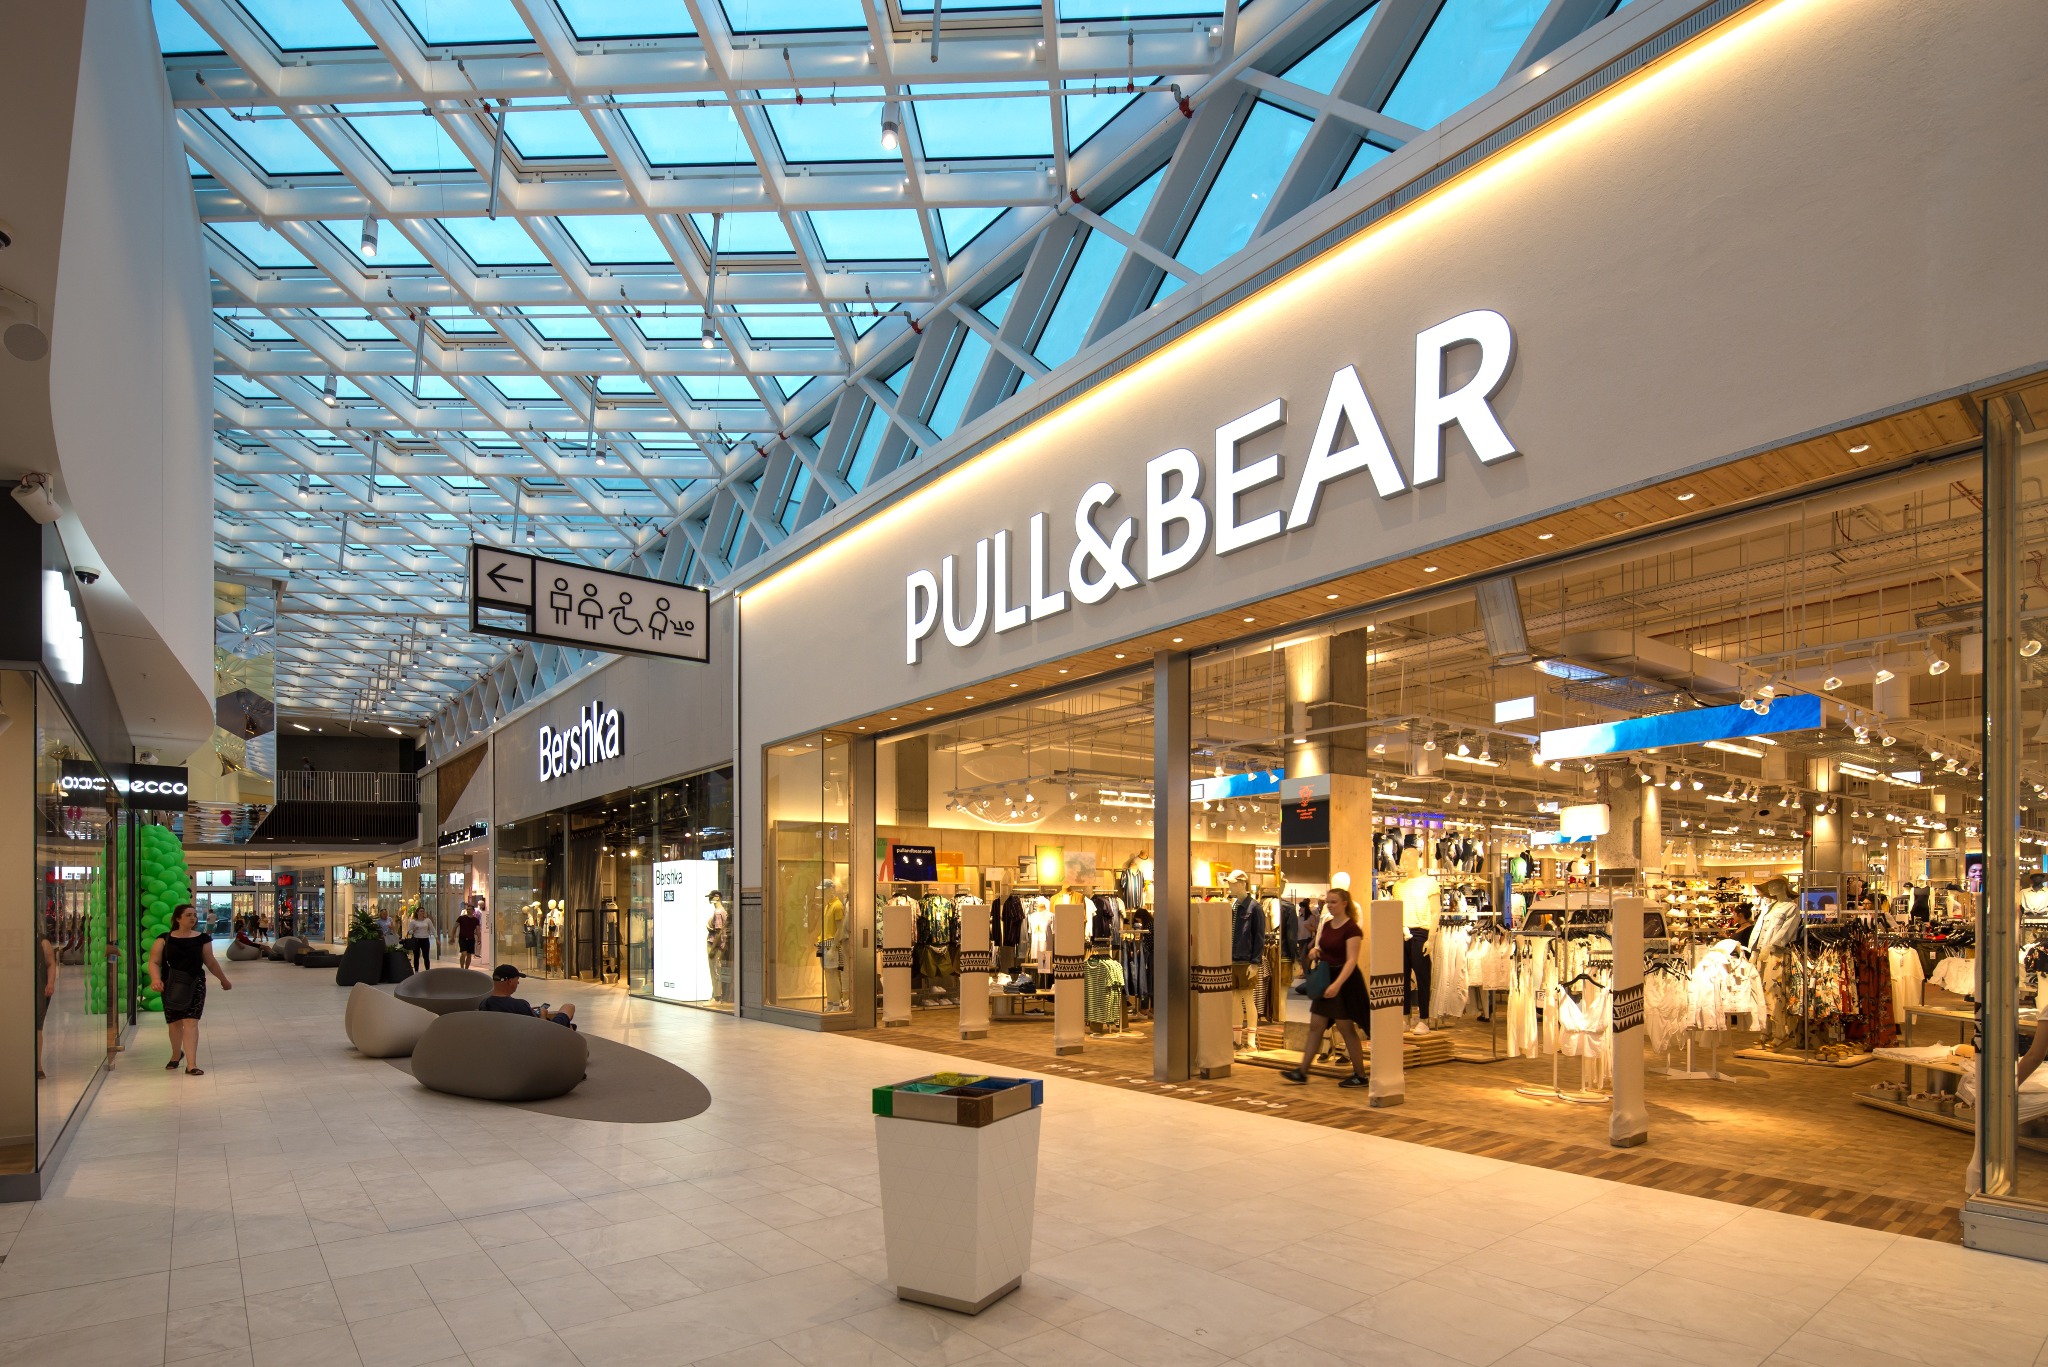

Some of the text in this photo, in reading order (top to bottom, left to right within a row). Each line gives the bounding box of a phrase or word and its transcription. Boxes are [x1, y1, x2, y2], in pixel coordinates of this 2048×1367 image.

[906, 309, 1523, 666] PULL&BEAR
[539, 699, 624, 782] Bershka
[130, 780, 188, 795] ecco
[655, 870, 683, 886] Bershka
[1114, 1075, 1148, 1085] TO
[1231, 1096, 1288, 1109] YOU
